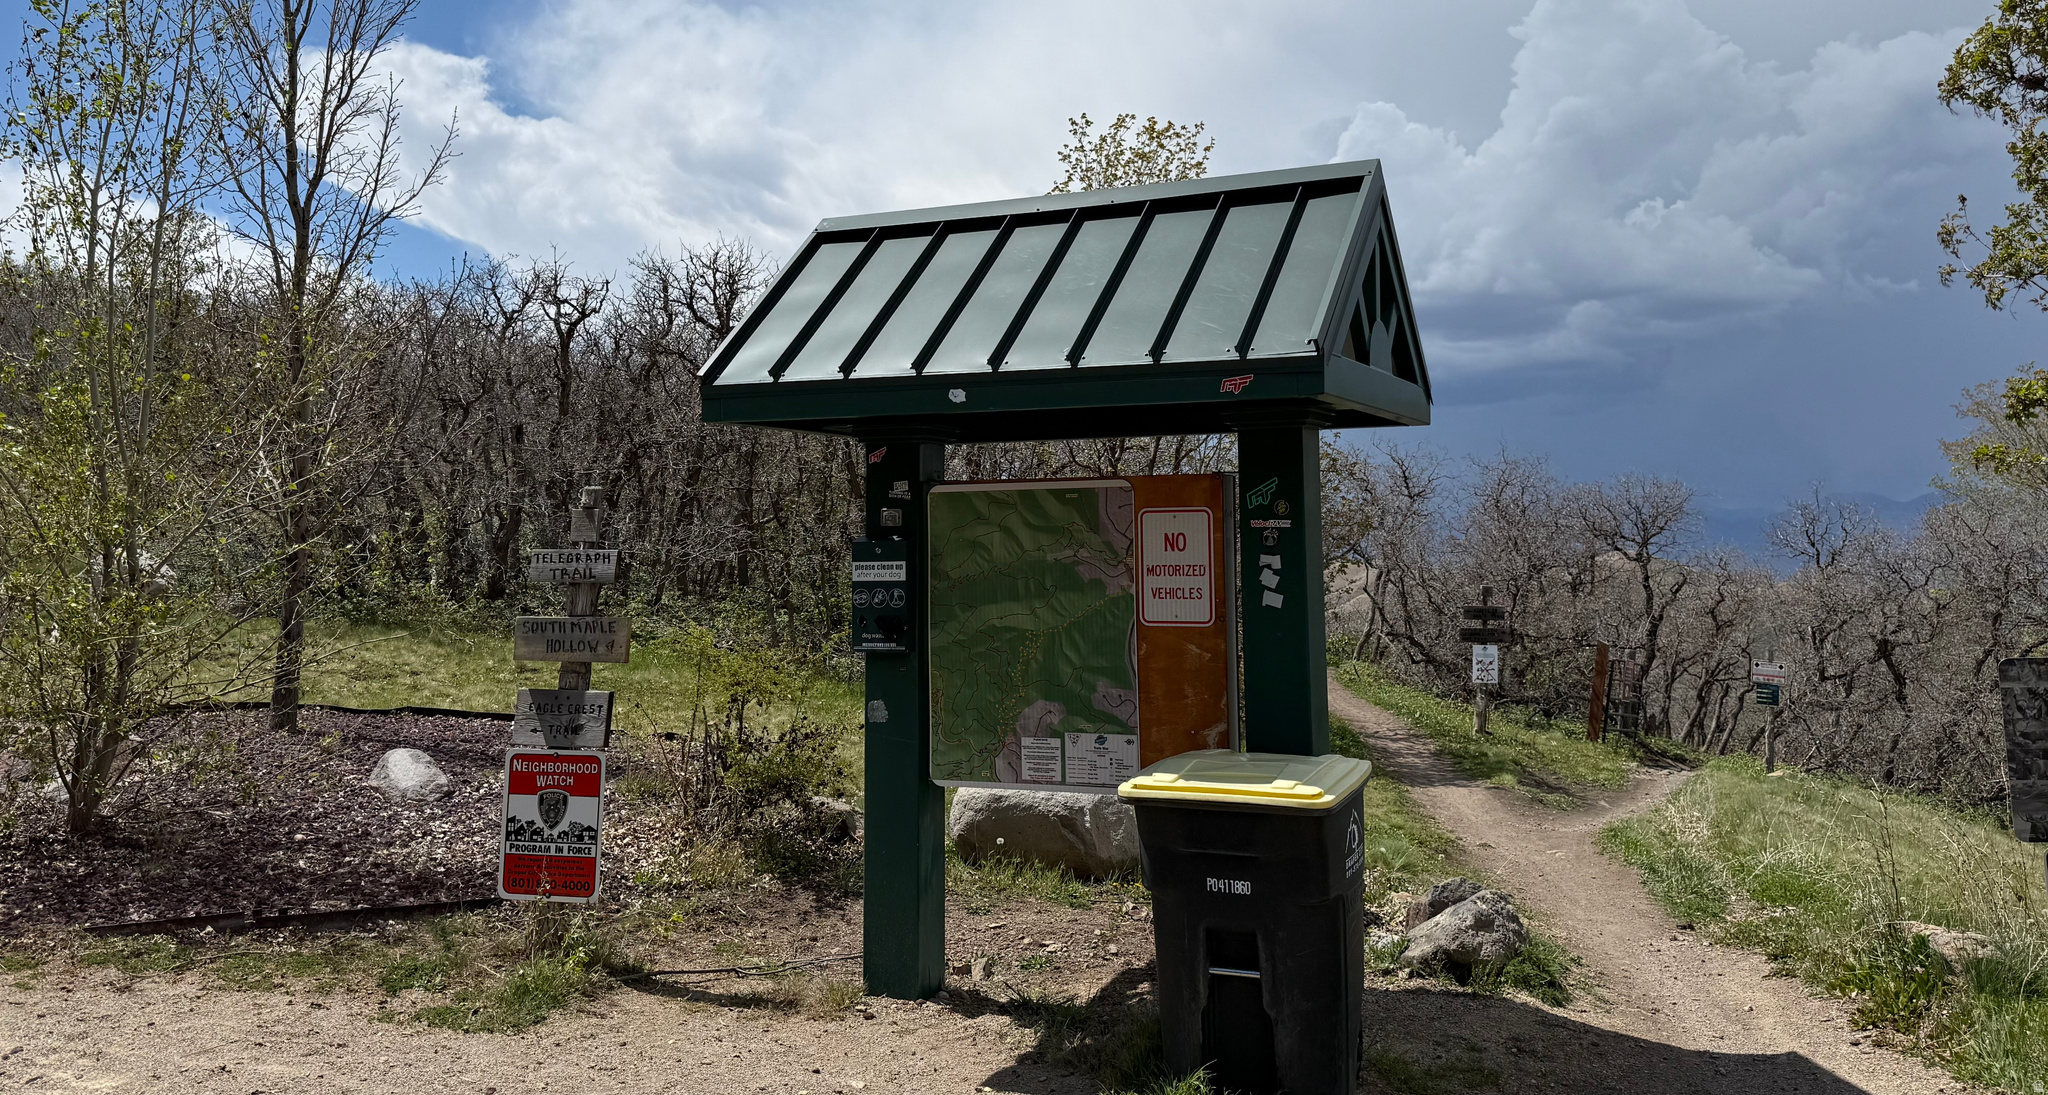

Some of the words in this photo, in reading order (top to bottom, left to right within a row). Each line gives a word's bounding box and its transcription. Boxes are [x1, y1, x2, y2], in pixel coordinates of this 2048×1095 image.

[1164, 532, 1187, 552] NO
[534, 553, 611, 565] TELEGRAPH
[549, 567, 597, 581] TRAIL
[854, 563, 876, 572] please
[876, 563, 894, 571] clean
[1146, 564, 1206, 577] MOTORIZED
[888, 571, 902, 580] dog
[1151, 587, 1203, 600] VEHICLES
[522, 621, 567, 635] SOUTH
[570, 620, 617, 634] MAPLE
[546, 639, 600, 654] HOLLOW
[528, 702, 563, 714] EAGLE
[567, 703, 604, 718] CREST
[548, 724, 581, 736] TRAIL
[512, 758, 598, 774] NEIGHBORHOOD
[536, 775, 574, 788] WATCH
[543, 792, 564, 800] POLICE
[509, 842, 551, 855] PROGRAM
[555, 844, 564, 855] IN
[567, 845, 592, 857] FORCE
